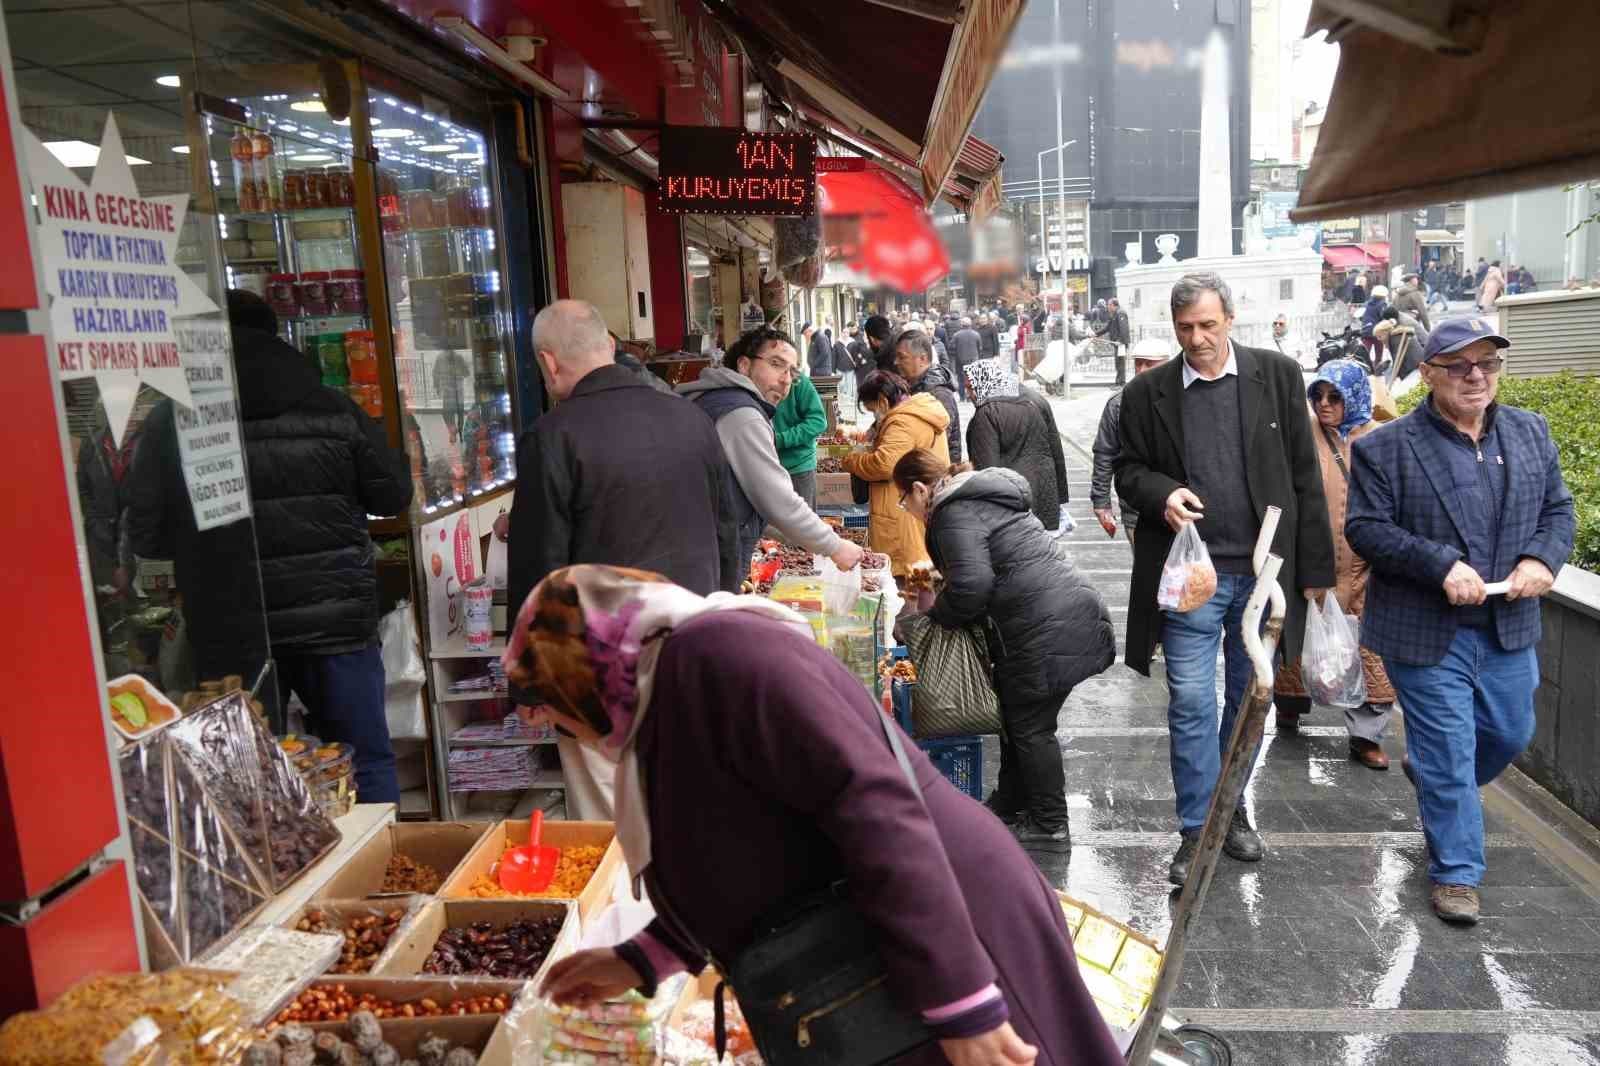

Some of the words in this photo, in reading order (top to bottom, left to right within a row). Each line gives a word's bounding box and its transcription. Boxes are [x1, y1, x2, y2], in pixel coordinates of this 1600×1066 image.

[44, 184, 91, 222] KINA
[668, 173, 805, 206] KURUYEMİŞ
[62, 229, 113, 261] TOPTAN
[1036, 253, 1089, 273] avm
[57, 268, 111, 306] KARIŞIK
[73, 307, 168, 333] HAZIRLANIR
[142, 342, 180, 369] ALINIR
[218, 477, 245, 497] TOZU
